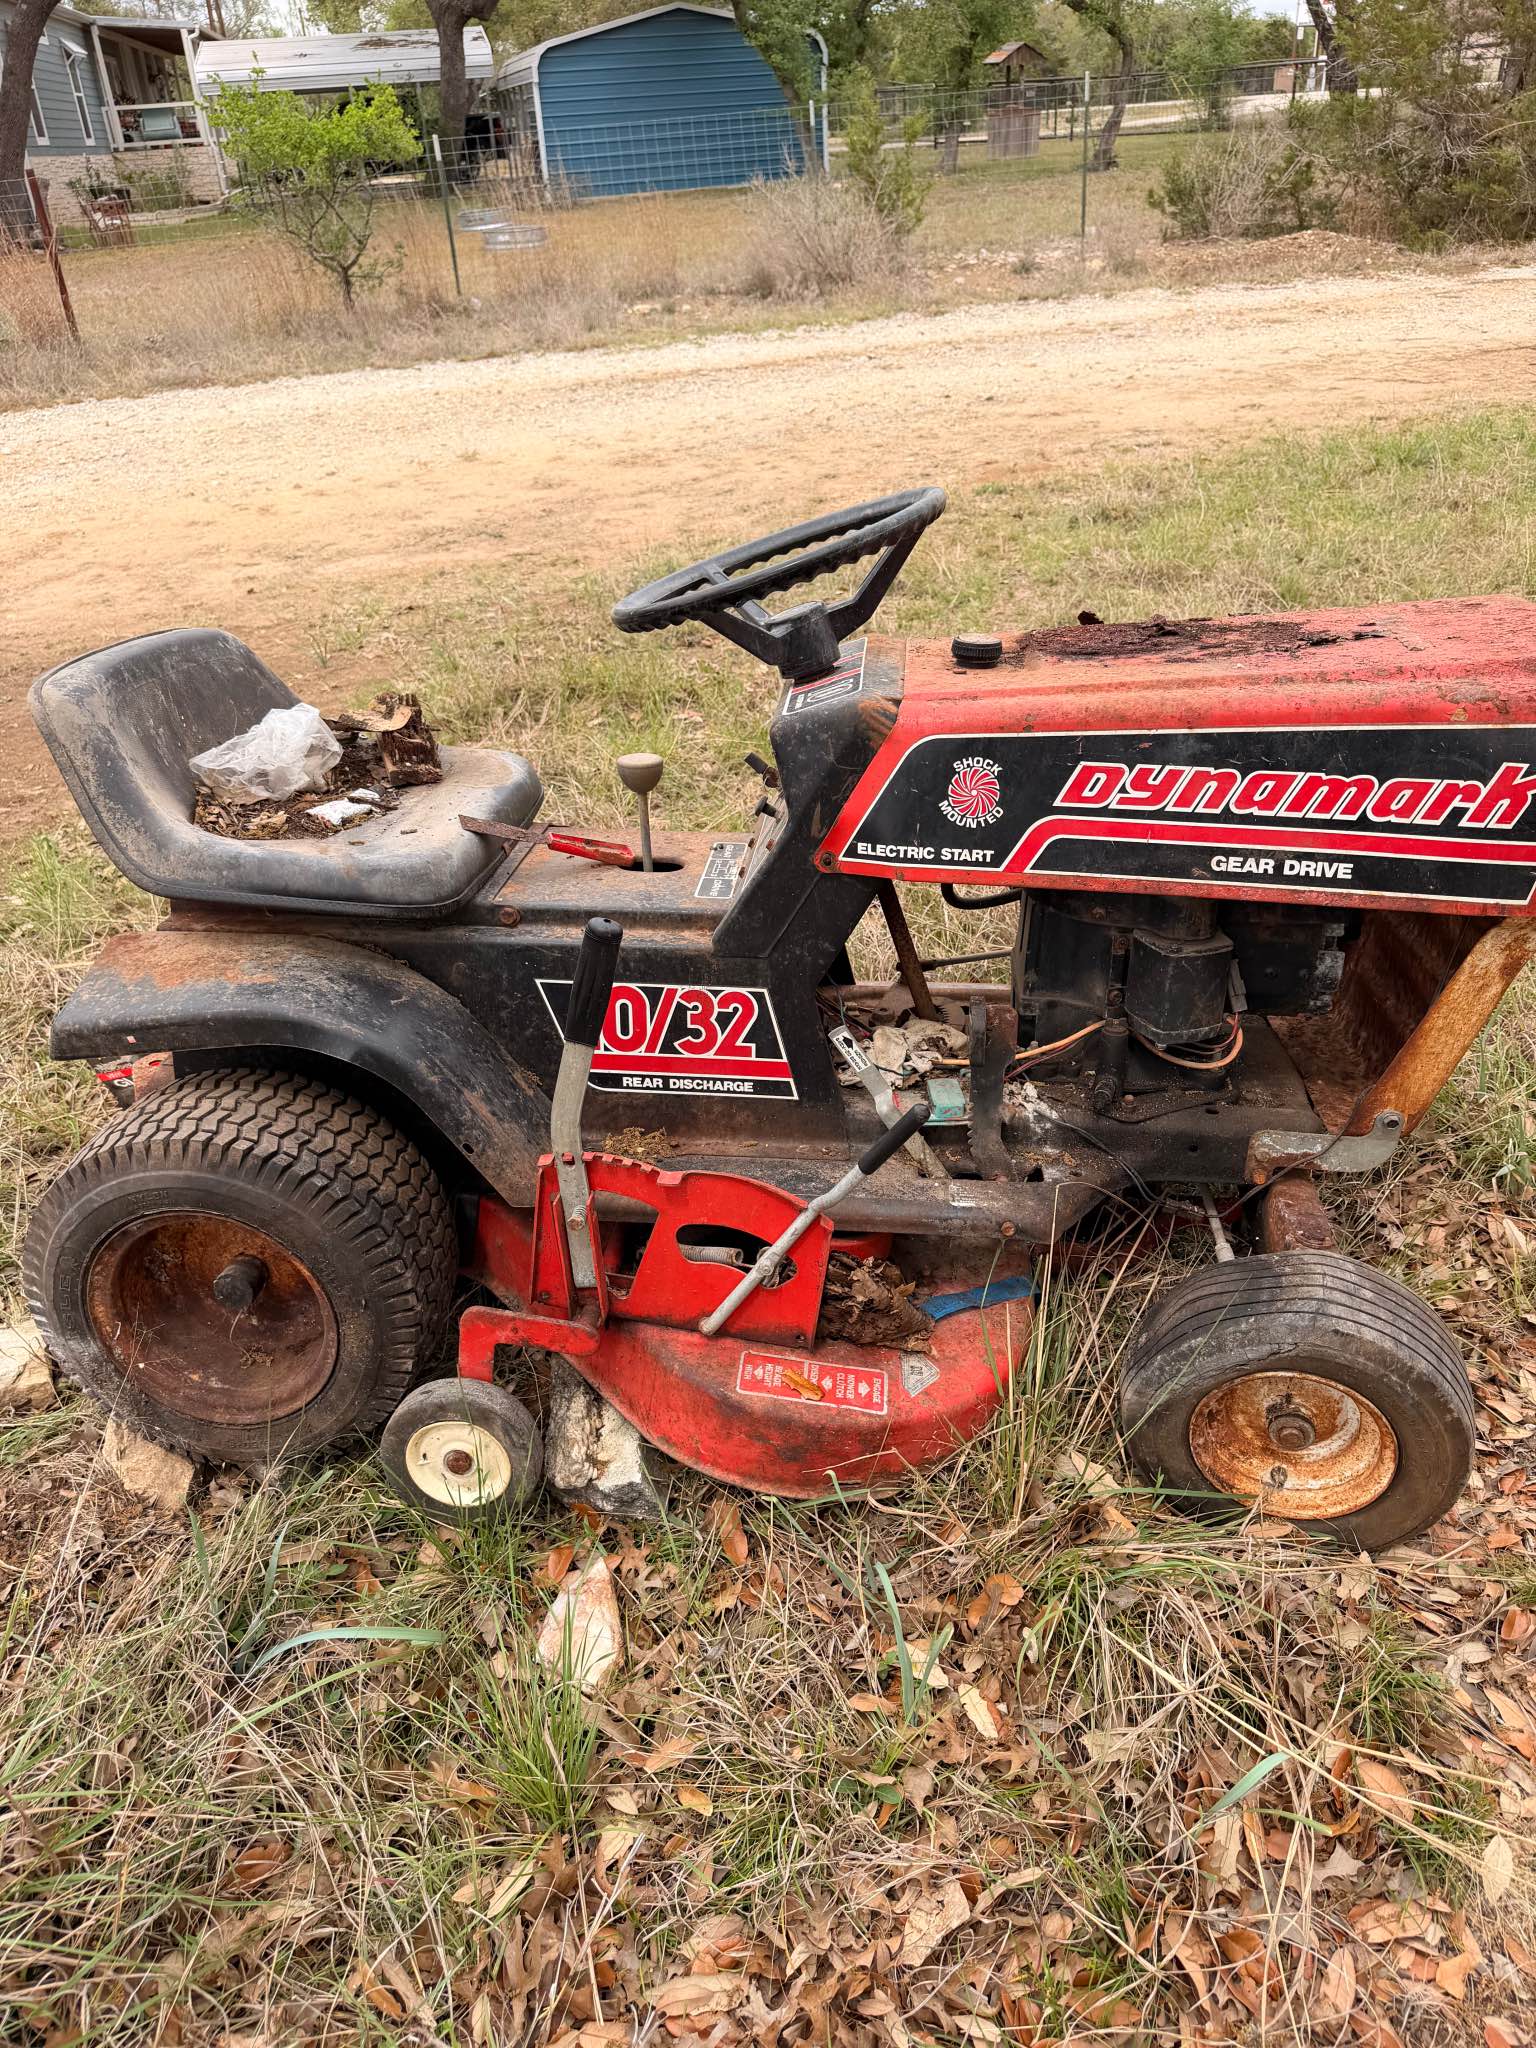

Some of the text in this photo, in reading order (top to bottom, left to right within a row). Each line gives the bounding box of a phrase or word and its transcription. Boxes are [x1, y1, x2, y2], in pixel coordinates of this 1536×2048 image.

[953, 757, 1003, 776] SHOCK
[938, 799, 1004, 829] MOUNTED
[857, 842, 995, 863] ELECTRIC START
[1210, 855, 1354, 880] GEAR DRIVE
[594, 984, 757, 1058] 0/32
[622, 1076, 754, 1092] REAR DISCHARGE
[835, 1372, 845, 1398] CLUTCH
[846, 1373, 855, 1399] MOWER
[872, 1377, 882, 1404] ENGAGE
